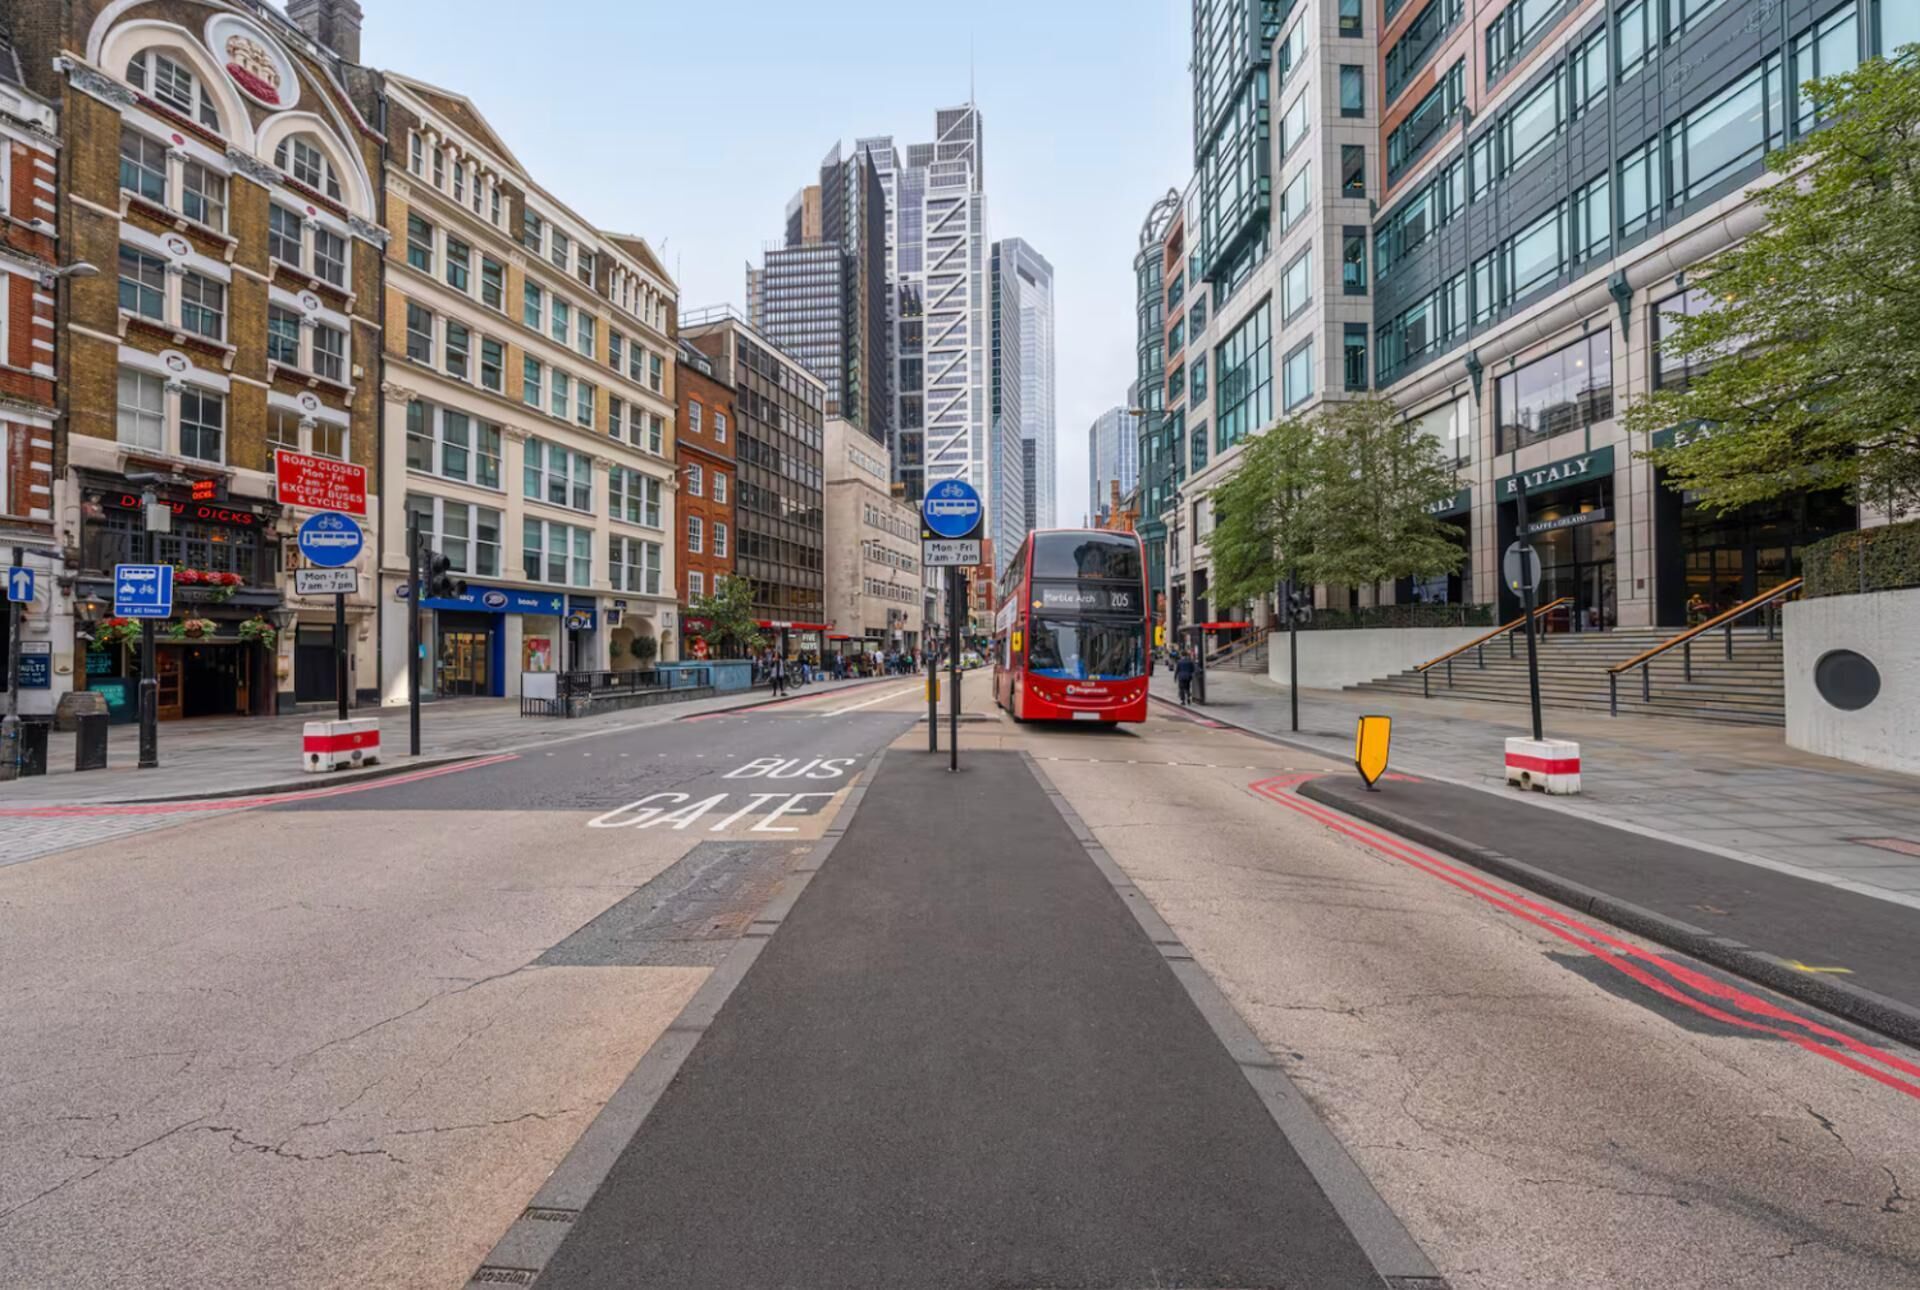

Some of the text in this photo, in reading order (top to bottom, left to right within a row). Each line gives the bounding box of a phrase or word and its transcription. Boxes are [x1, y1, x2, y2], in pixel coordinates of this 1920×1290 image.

[282, 454, 361, 476] ROAD CLOSED
[302, 467, 324, 478] Mon
[332, 472, 345, 482] Fri
[282, 482, 363, 503] EXCEPT BUSES
[120, 494, 253, 525] DIY DICKS
[308, 496, 350, 510] CYCLES
[932, 544, 952, 552] Mon
[960, 544, 973, 552] Fri
[304, 572, 327, 581] Mon
[334, 571, 348, 580] Fri
[1044, 592, 1129, 607] Marble Arch 205
[18, 664, 46, 672] AULTS
[722, 758, 856, 780] BUS
[587, 792, 838, 832] GATE
